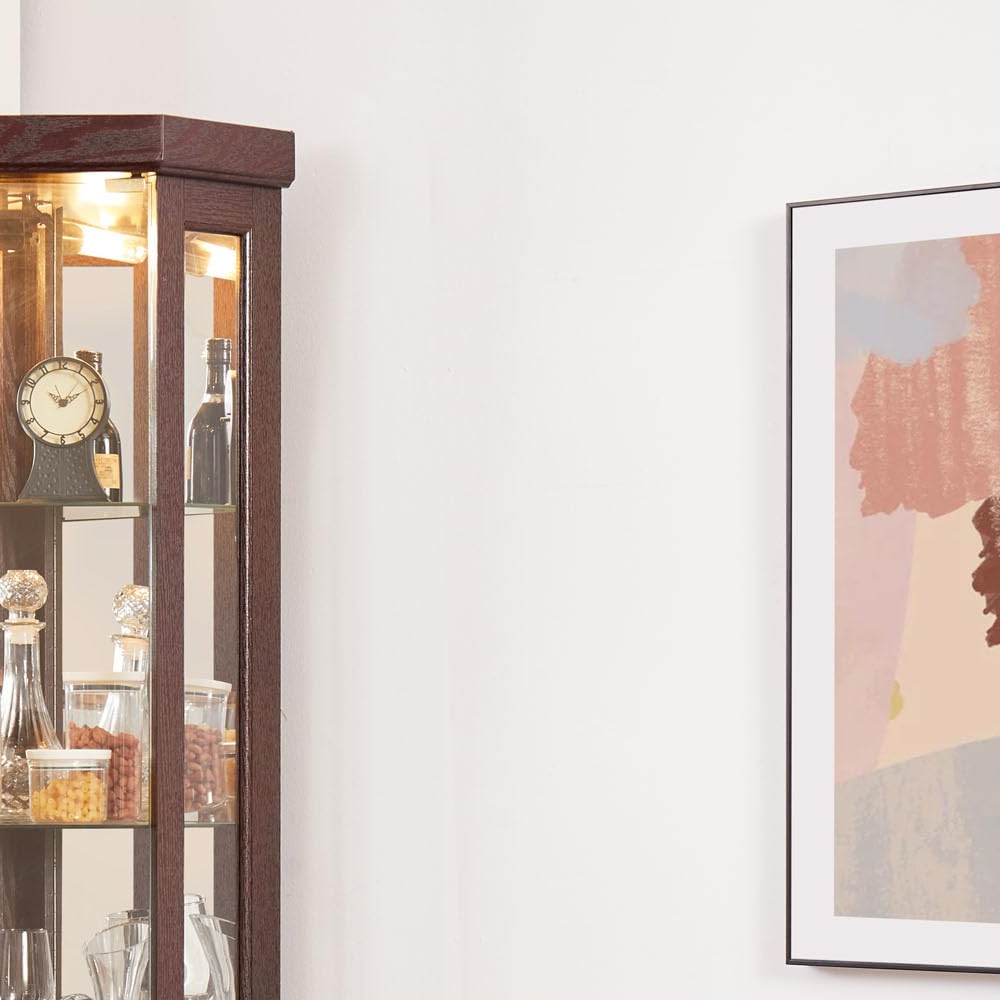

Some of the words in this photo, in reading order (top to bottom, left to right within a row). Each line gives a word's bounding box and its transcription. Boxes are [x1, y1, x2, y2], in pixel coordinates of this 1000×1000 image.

[40, 364, 48, 374] 11
[59, 361, 68, 370] 12
[25, 378, 35, 389] 10
[26, 417, 35, 425] 8
[41, 430, 49, 440] 7
[77, 431, 86, 440] 5
[60, 435, 66, 446] 6
